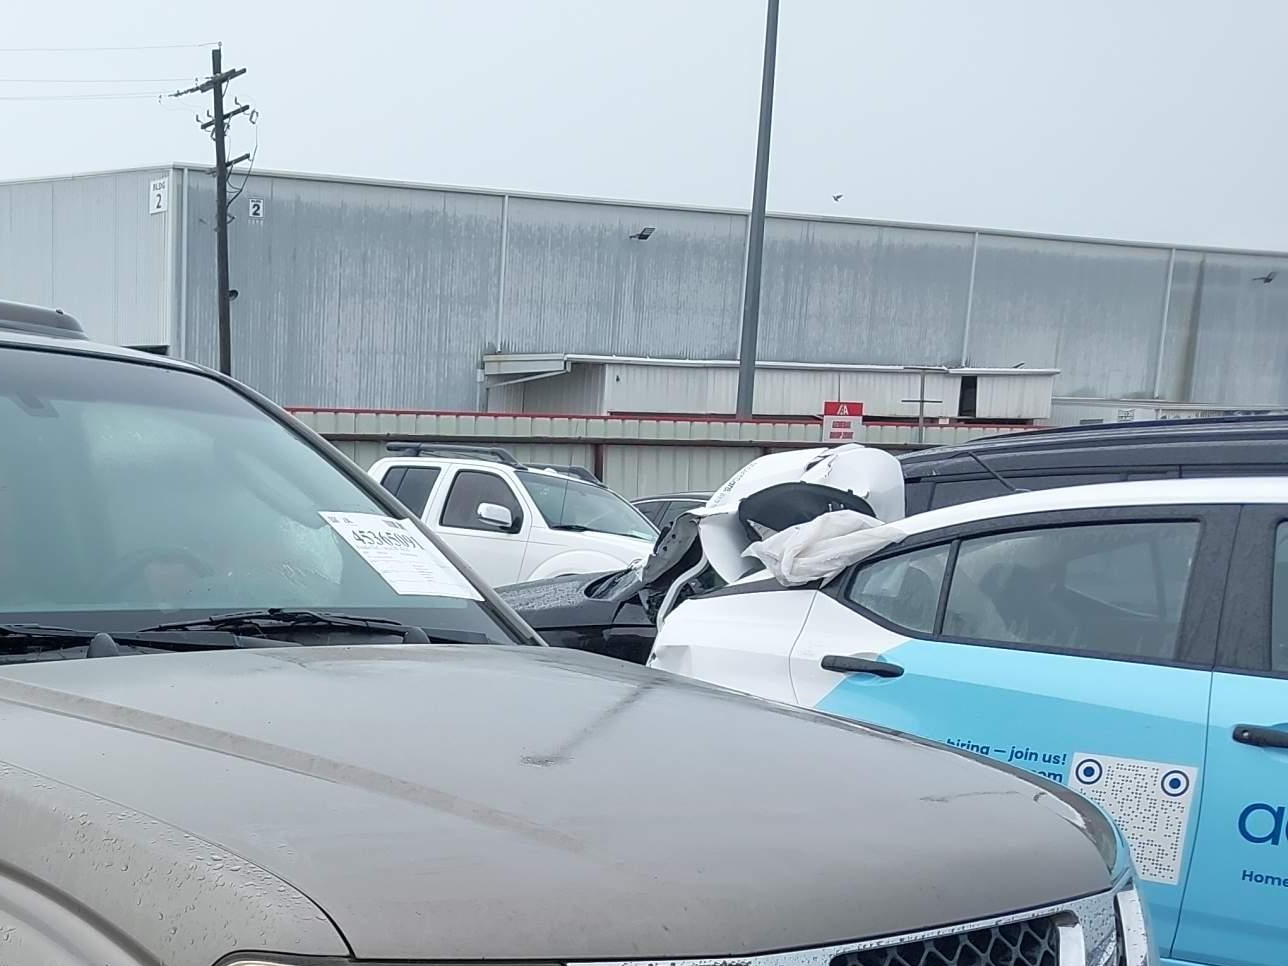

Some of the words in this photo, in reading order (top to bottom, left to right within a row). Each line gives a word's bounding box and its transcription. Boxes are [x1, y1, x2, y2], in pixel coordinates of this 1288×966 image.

[156, 193, 162, 209] 2
[252, 203, 260, 216] 2
[351, 529, 425, 550] 45365091
[1008, 745, 1038, 762] join
[1042, 753, 1067, 766] us!
